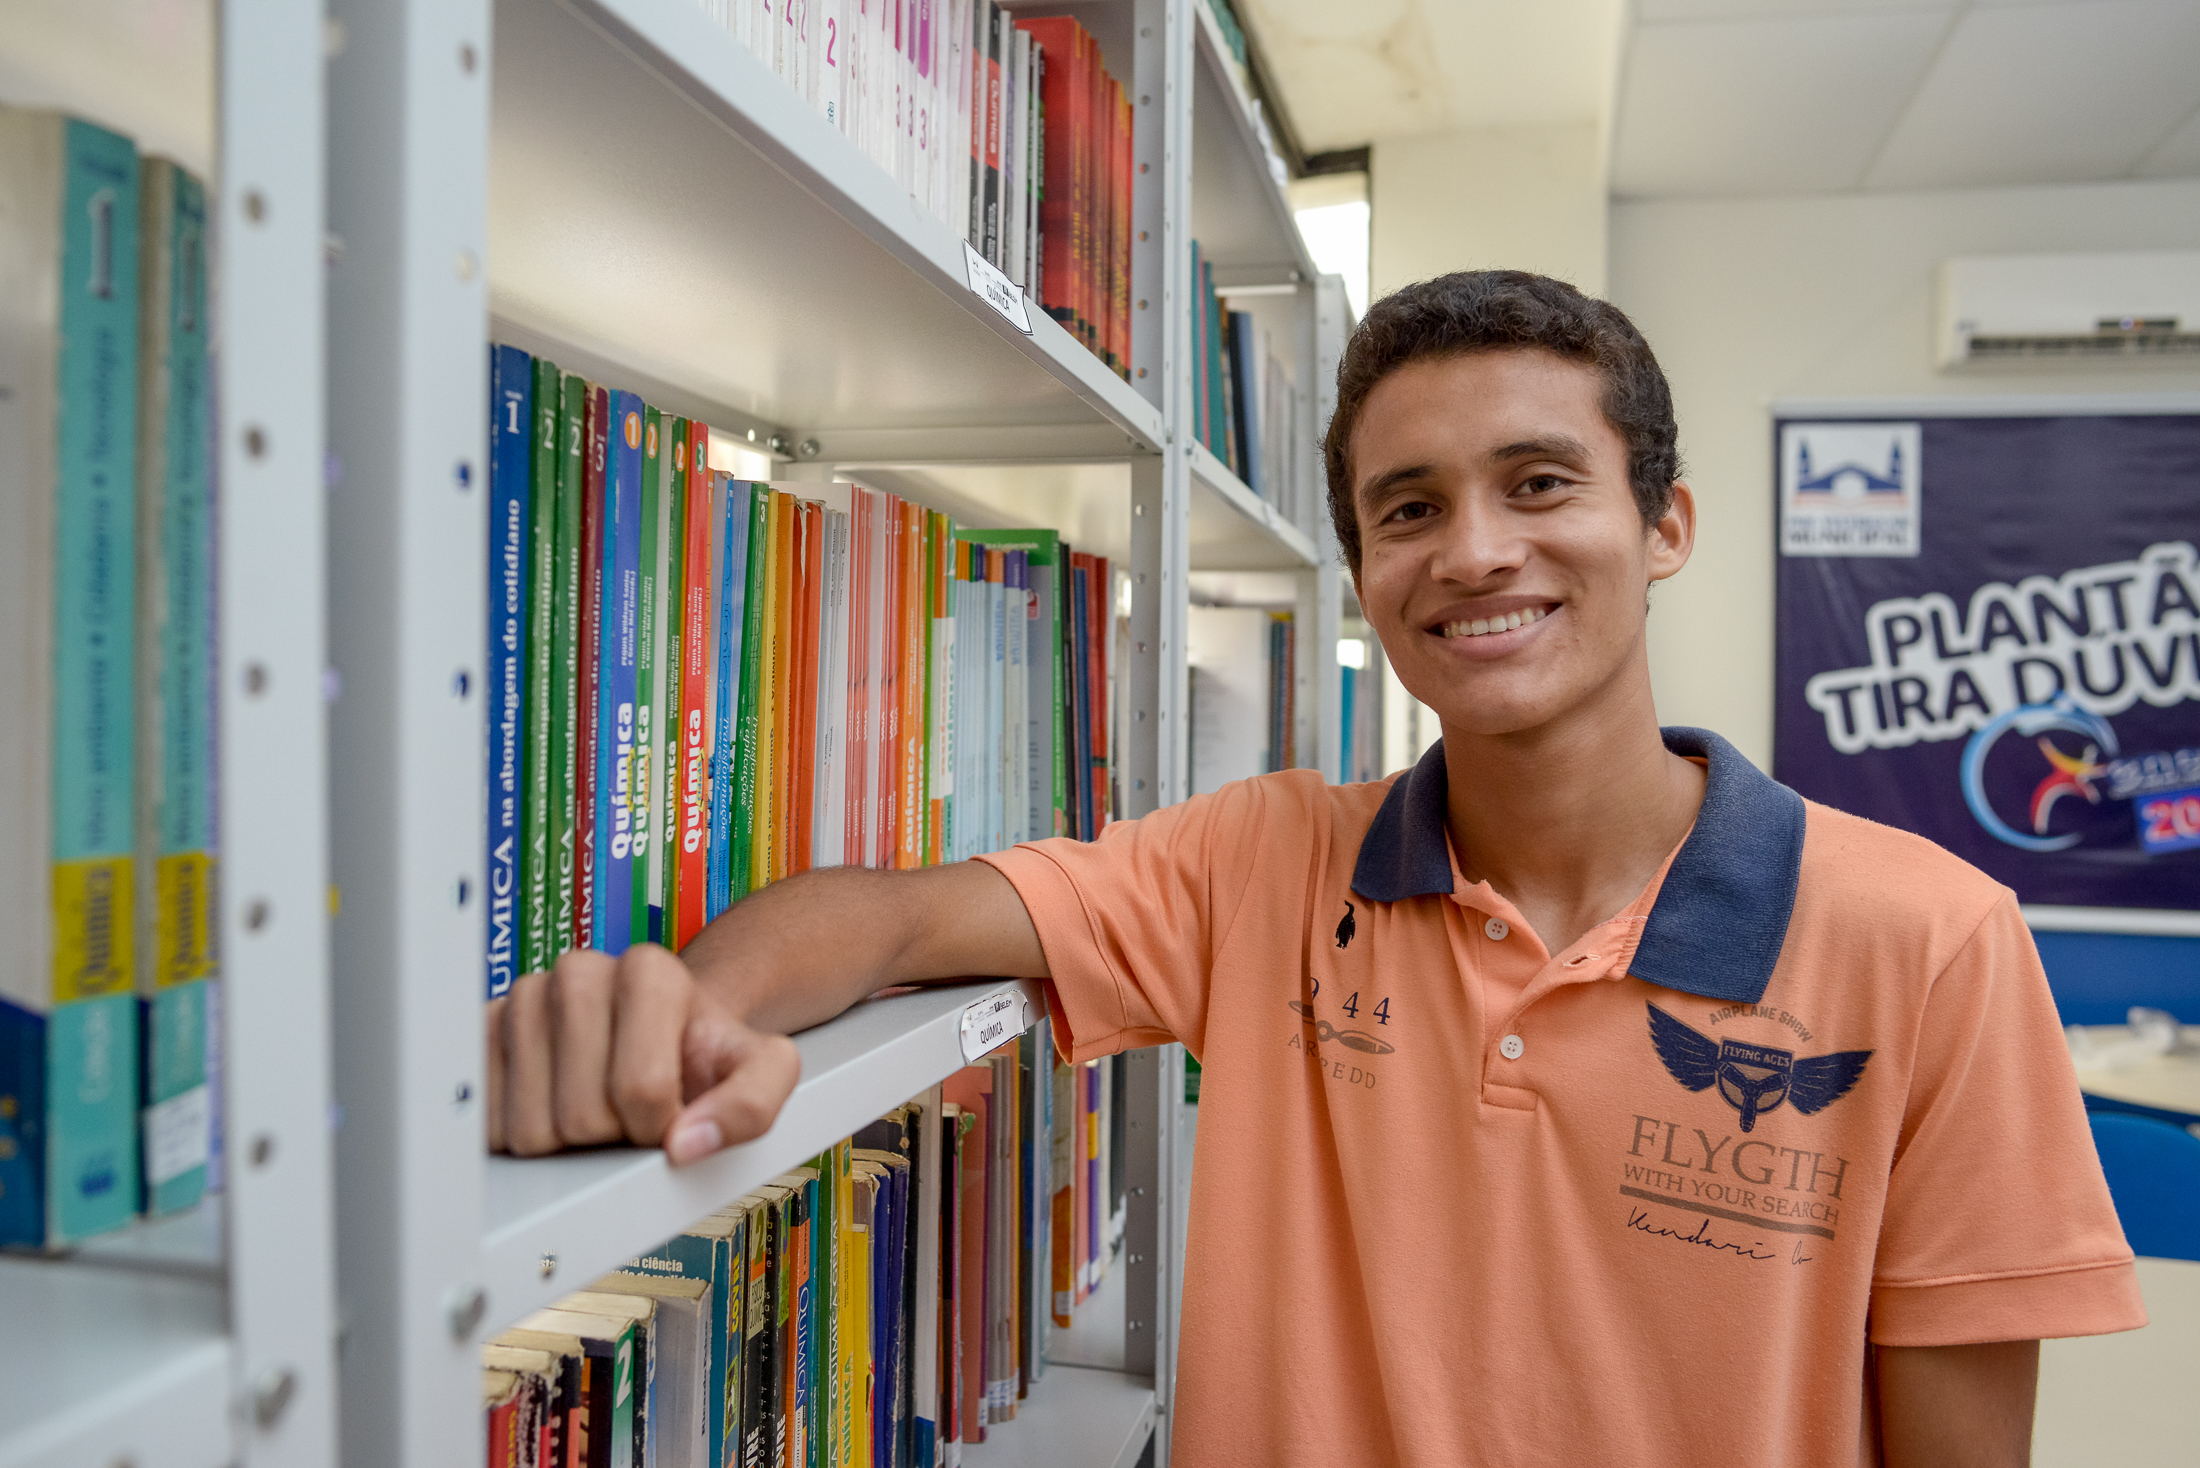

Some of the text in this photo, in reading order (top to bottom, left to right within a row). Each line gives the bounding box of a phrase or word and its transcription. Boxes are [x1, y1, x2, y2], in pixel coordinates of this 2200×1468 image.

[827, 17, 836, 68] 2
[920, 108, 927, 150] 3
[986, 284, 1011, 313] QUÍMICA
[507, 400, 521, 434] 1
[543, 416, 555, 450] 2
[569, 424, 581, 458] 2
[629, 414, 638, 446] 1
[648, 424, 657, 455] 2
[595, 441, 605, 472] 3
[676, 444, 685, 469] 2
[697, 443, 705, 468] 3
[760, 503, 766, 523] 3
[540, 543, 552, 641] cotidiano
[539, 646, 550, 672] do
[537, 677, 550, 793] abordagem
[1824, 668, 1991, 738] TIRA
[487, 499, 521, 998] UÍMICA na abordagem do cotidiano
[556, 547, 579, 956] UÍMICA na abordagem do cotidiano
[580, 569, 602, 949] UÍMICA na abordagem do cotidiano
[611, 702, 633, 859] Química
[683, 708, 702, 853] Química
[720, 716, 730, 840] Transformações
[740, 729, 751, 806] aplicações
[747, 715, 759, 835] Transformações
[537, 799, 547, 823] na
[632, 705, 650, 857] Química
[665, 741, 677, 843] Química
[904, 736, 915, 854] QUÍMICA
[916, 744, 925, 858] QUÍMICA
[980, 1020, 1004, 1045] QUÍMICA
[1709, 1004, 1814, 1044] AIRPLANE SHOW
[1723, 1044, 1790, 1068] FLYING ACES
[1626, 1114, 1850, 1202] FLYGTH
[1624, 1162, 1839, 1226] WITH YOUR SEARCH
[642, 1257, 683, 1273] ciência
[754, 1208, 765, 1268] 2
[731, 1252, 740, 1334] COVRE
[616, 1338, 632, 1410] 2
[796, 1286, 810, 1406] QUÍMICA
[841, 1354, 852, 1466] QUÍMICA
[746, 1426, 759, 1468] VRE
